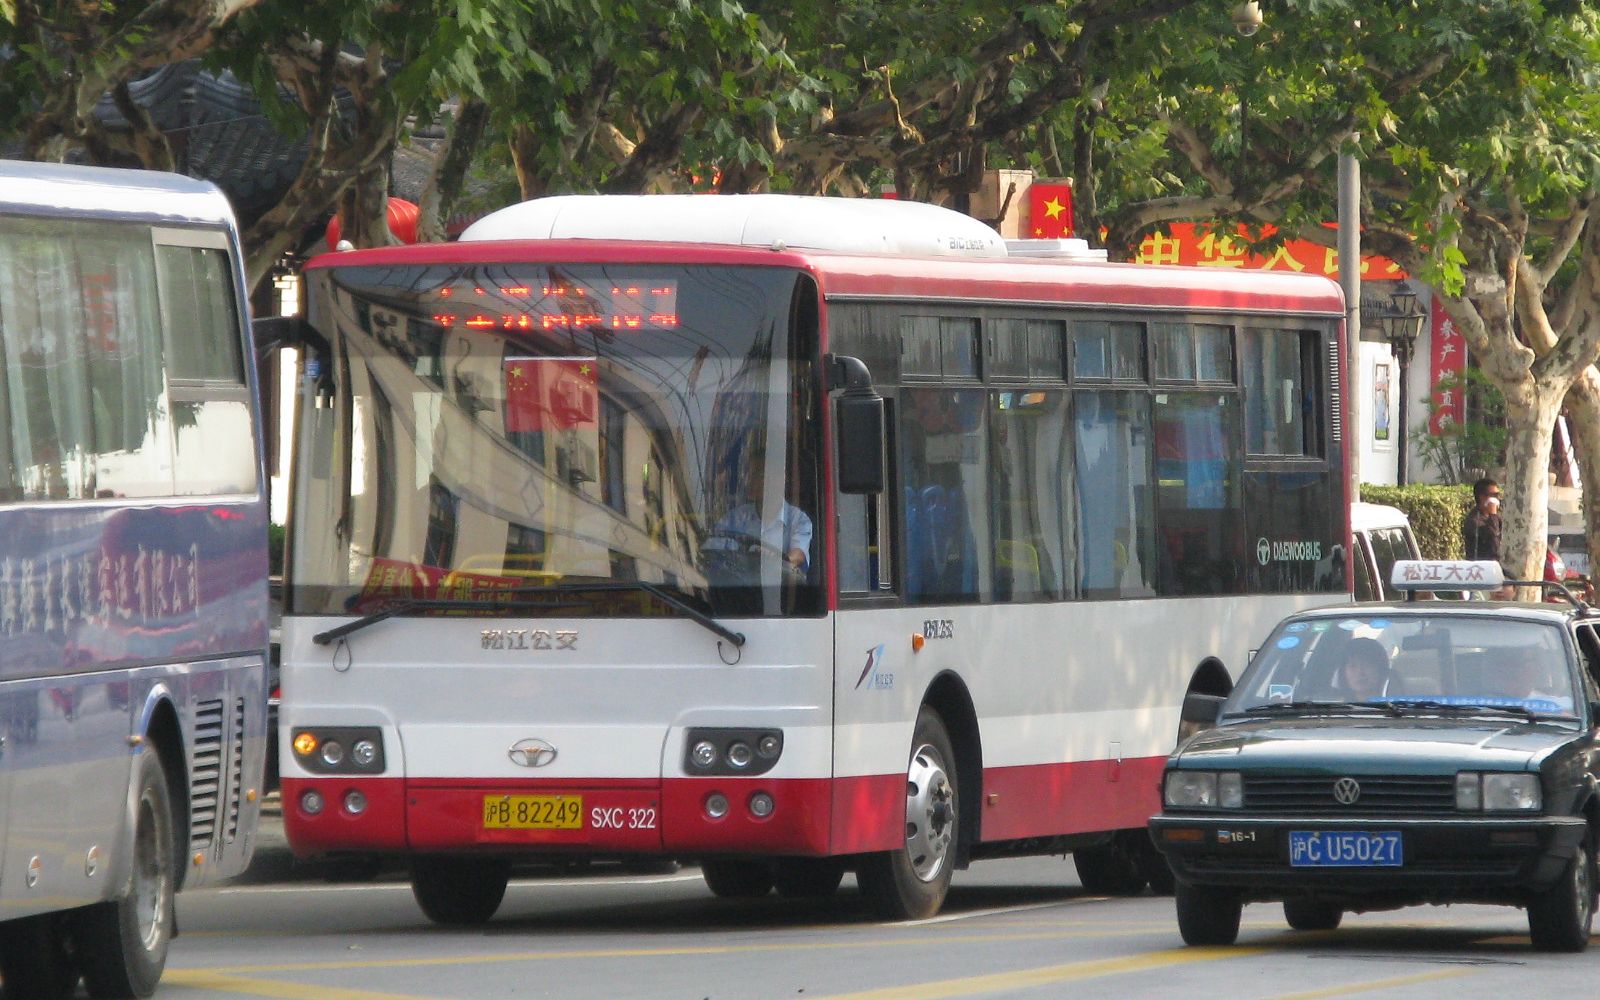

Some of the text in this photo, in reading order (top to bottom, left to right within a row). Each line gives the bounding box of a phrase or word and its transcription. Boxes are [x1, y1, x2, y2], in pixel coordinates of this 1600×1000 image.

[1403, 564, 1485, 582] 松江大众
[481, 629, 578, 651] 松江公交
[591, 807, 656, 829] SXC 322
[1231, 831, 1256, 842] 16-1
